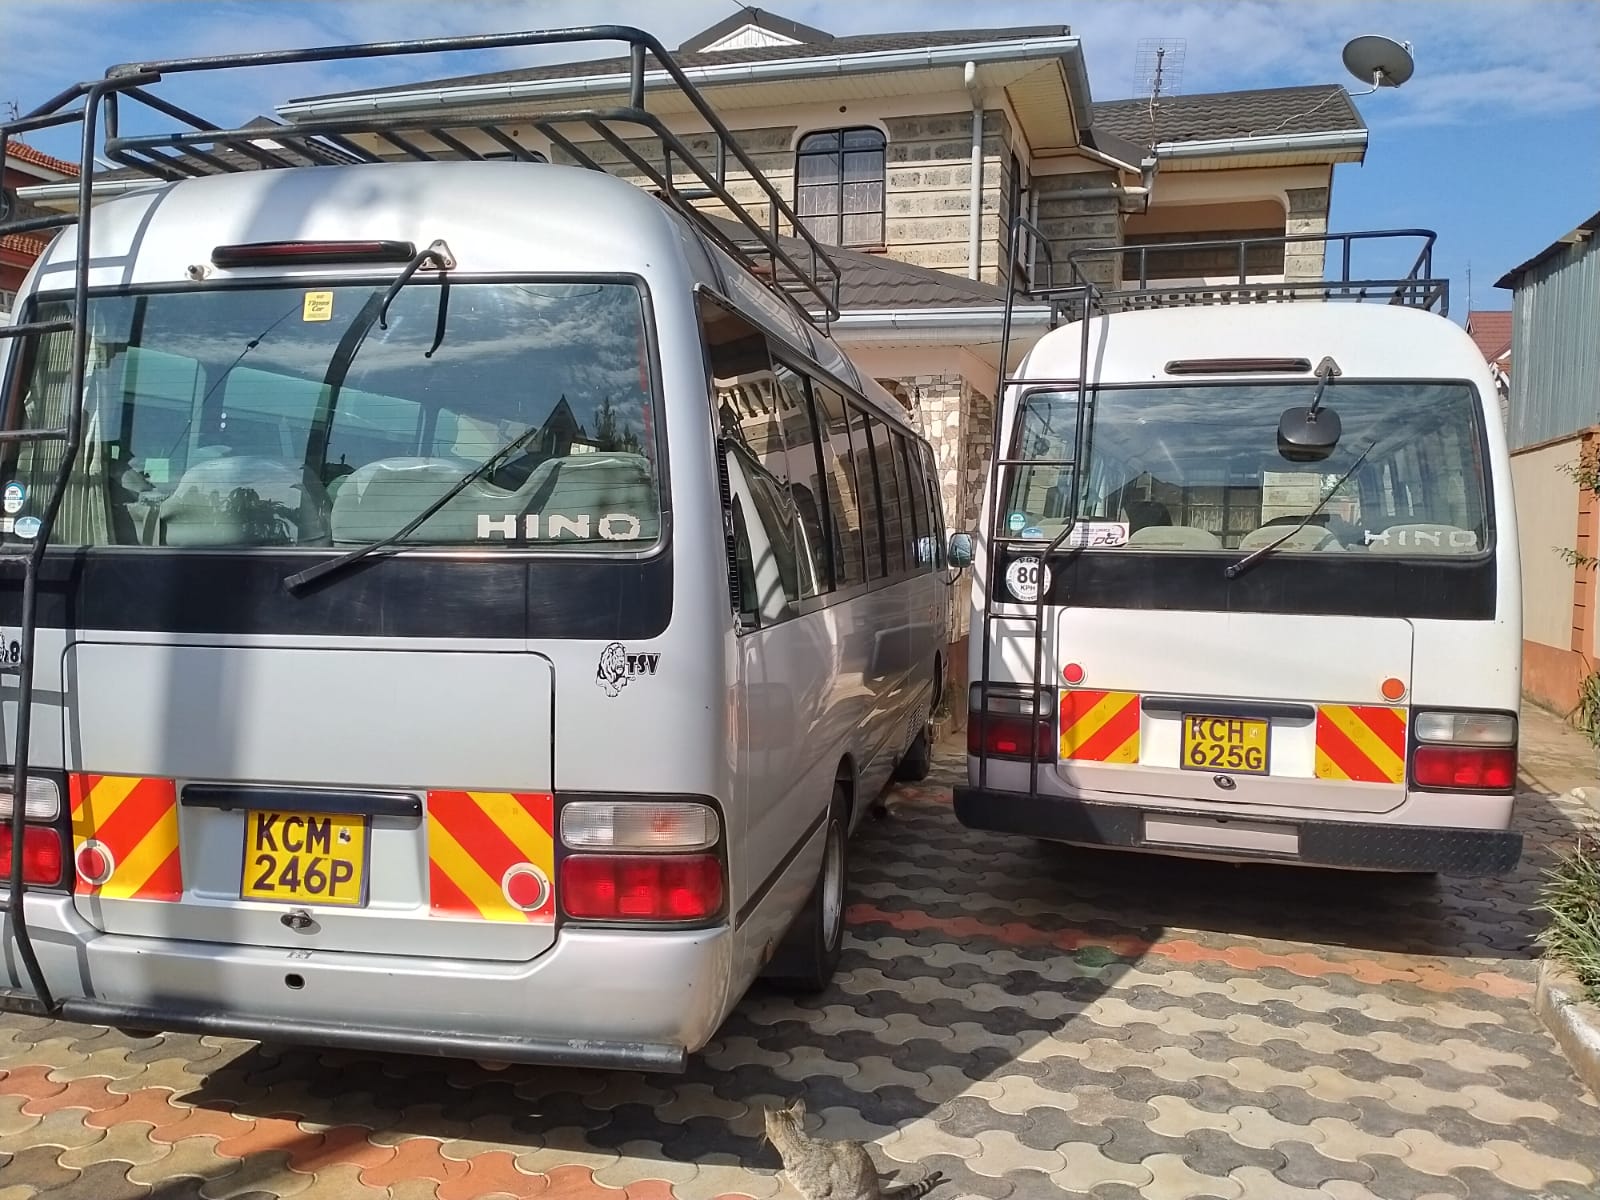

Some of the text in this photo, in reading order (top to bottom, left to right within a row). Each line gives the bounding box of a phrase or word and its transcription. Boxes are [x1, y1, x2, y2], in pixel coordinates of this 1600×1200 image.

[477, 514, 641, 540] HINO
[1364, 530, 1478, 547] HINO
[1017, 567, 1038, 584] 80
[626, 653, 660, 675] TSV
[1191, 717, 1244, 743] KCH
[1190, 742, 1262, 769] 625G
[256, 813, 332, 854] KCM
[253, 854, 354, 897] 246P
